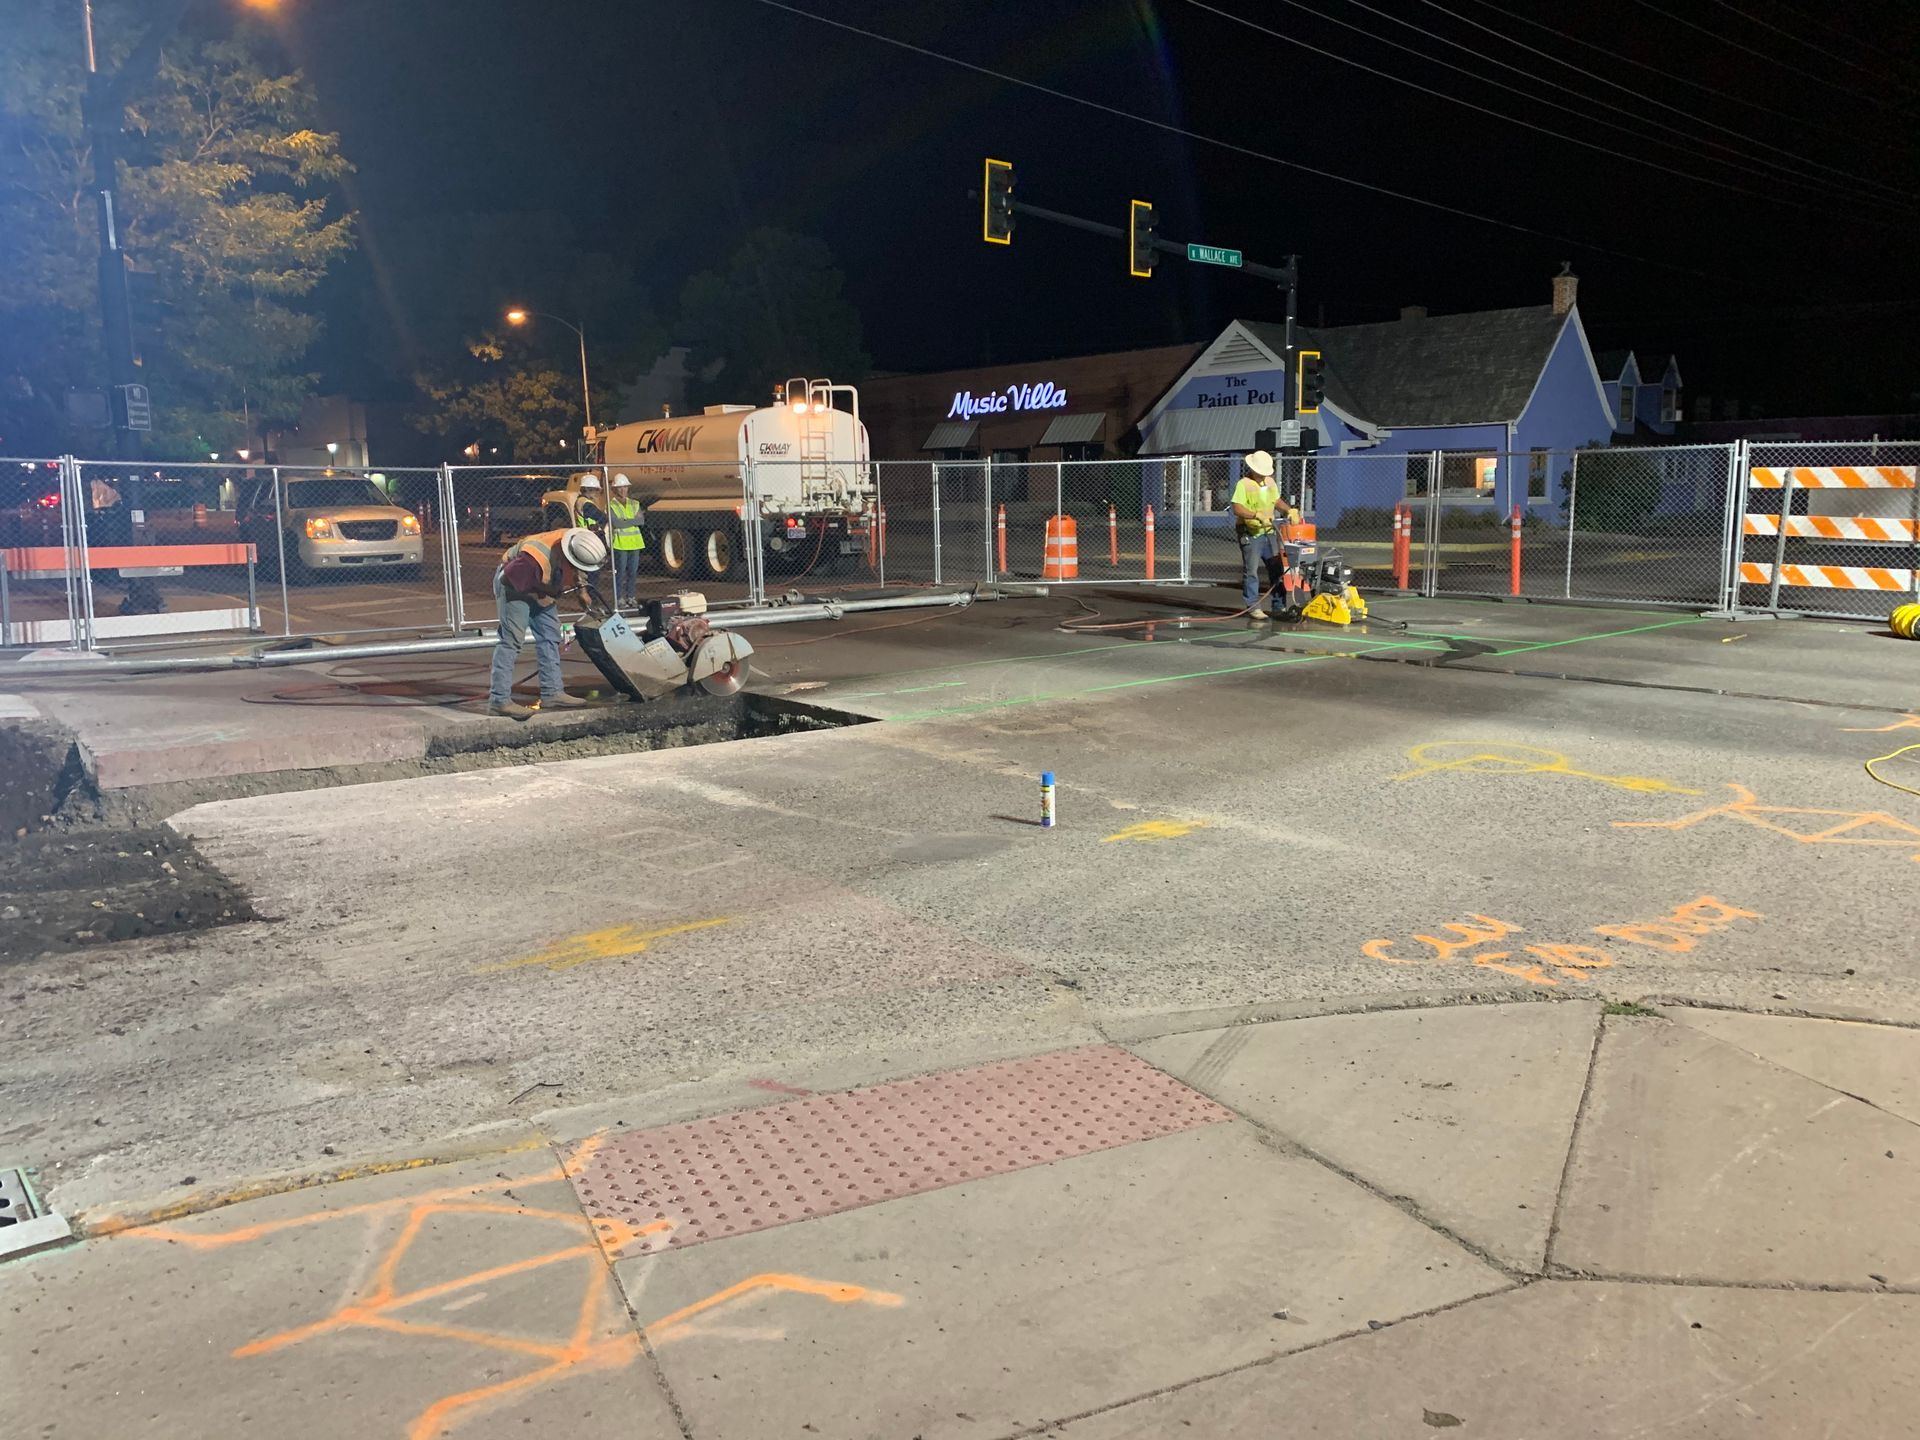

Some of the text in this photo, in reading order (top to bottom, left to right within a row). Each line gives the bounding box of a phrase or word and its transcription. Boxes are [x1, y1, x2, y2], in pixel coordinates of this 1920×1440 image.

[1199, 247, 1226, 263] WALLACE
[1229, 255, 1239, 265] AVE
[1225, 376, 1248, 388] The
[947, 381, 1067, 421] Music Villa
[1197, 389, 1276, 408] Paint Pot
[610, 623, 626, 639] 15
